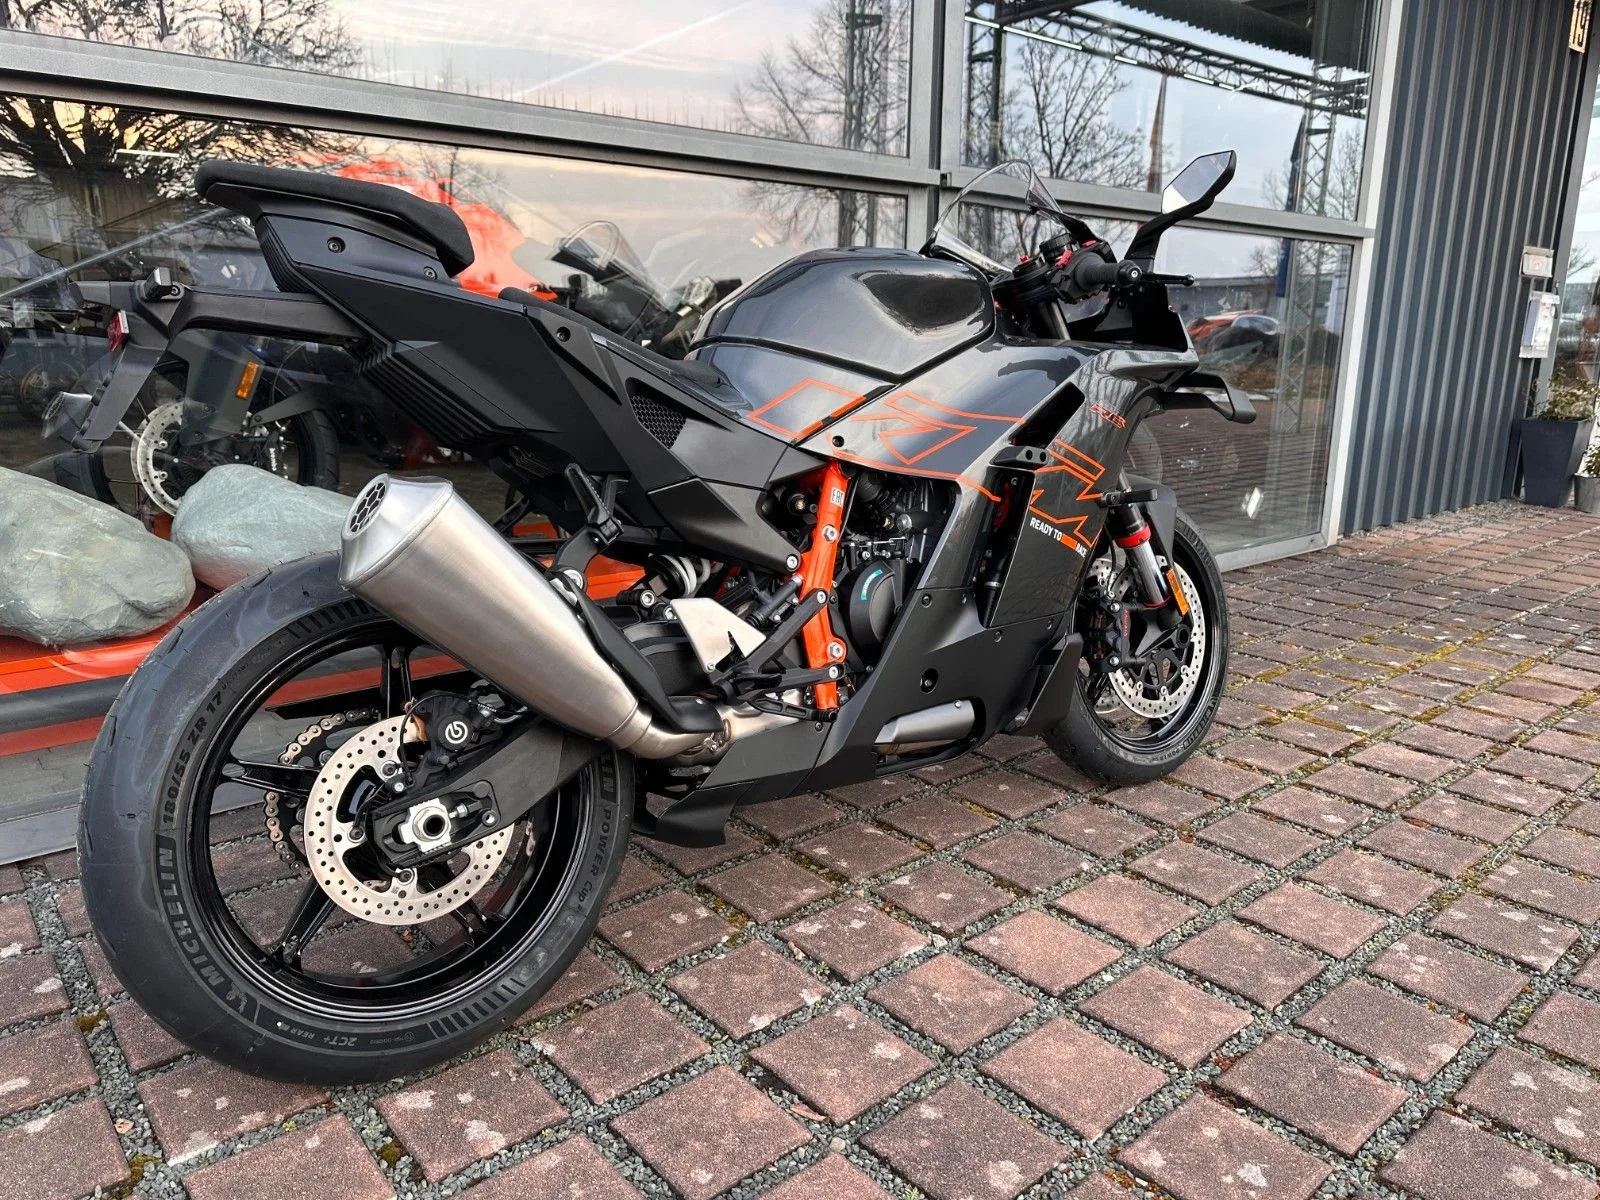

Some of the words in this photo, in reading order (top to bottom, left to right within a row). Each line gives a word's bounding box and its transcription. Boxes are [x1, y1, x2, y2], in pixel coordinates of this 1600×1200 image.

[1029, 516, 1054, 537] READY
[1053, 529, 1063, 542] TO
[162, 749, 191, 824] 180/55
[187, 716, 208, 745] ZR
[206, 691, 222, 713] 17
[590, 808, 612, 877] POWER
[577, 880, 593, 903] Cup
[159, 847, 225, 987] MICHELIN
[291, 1026, 316, 1040] REAR
